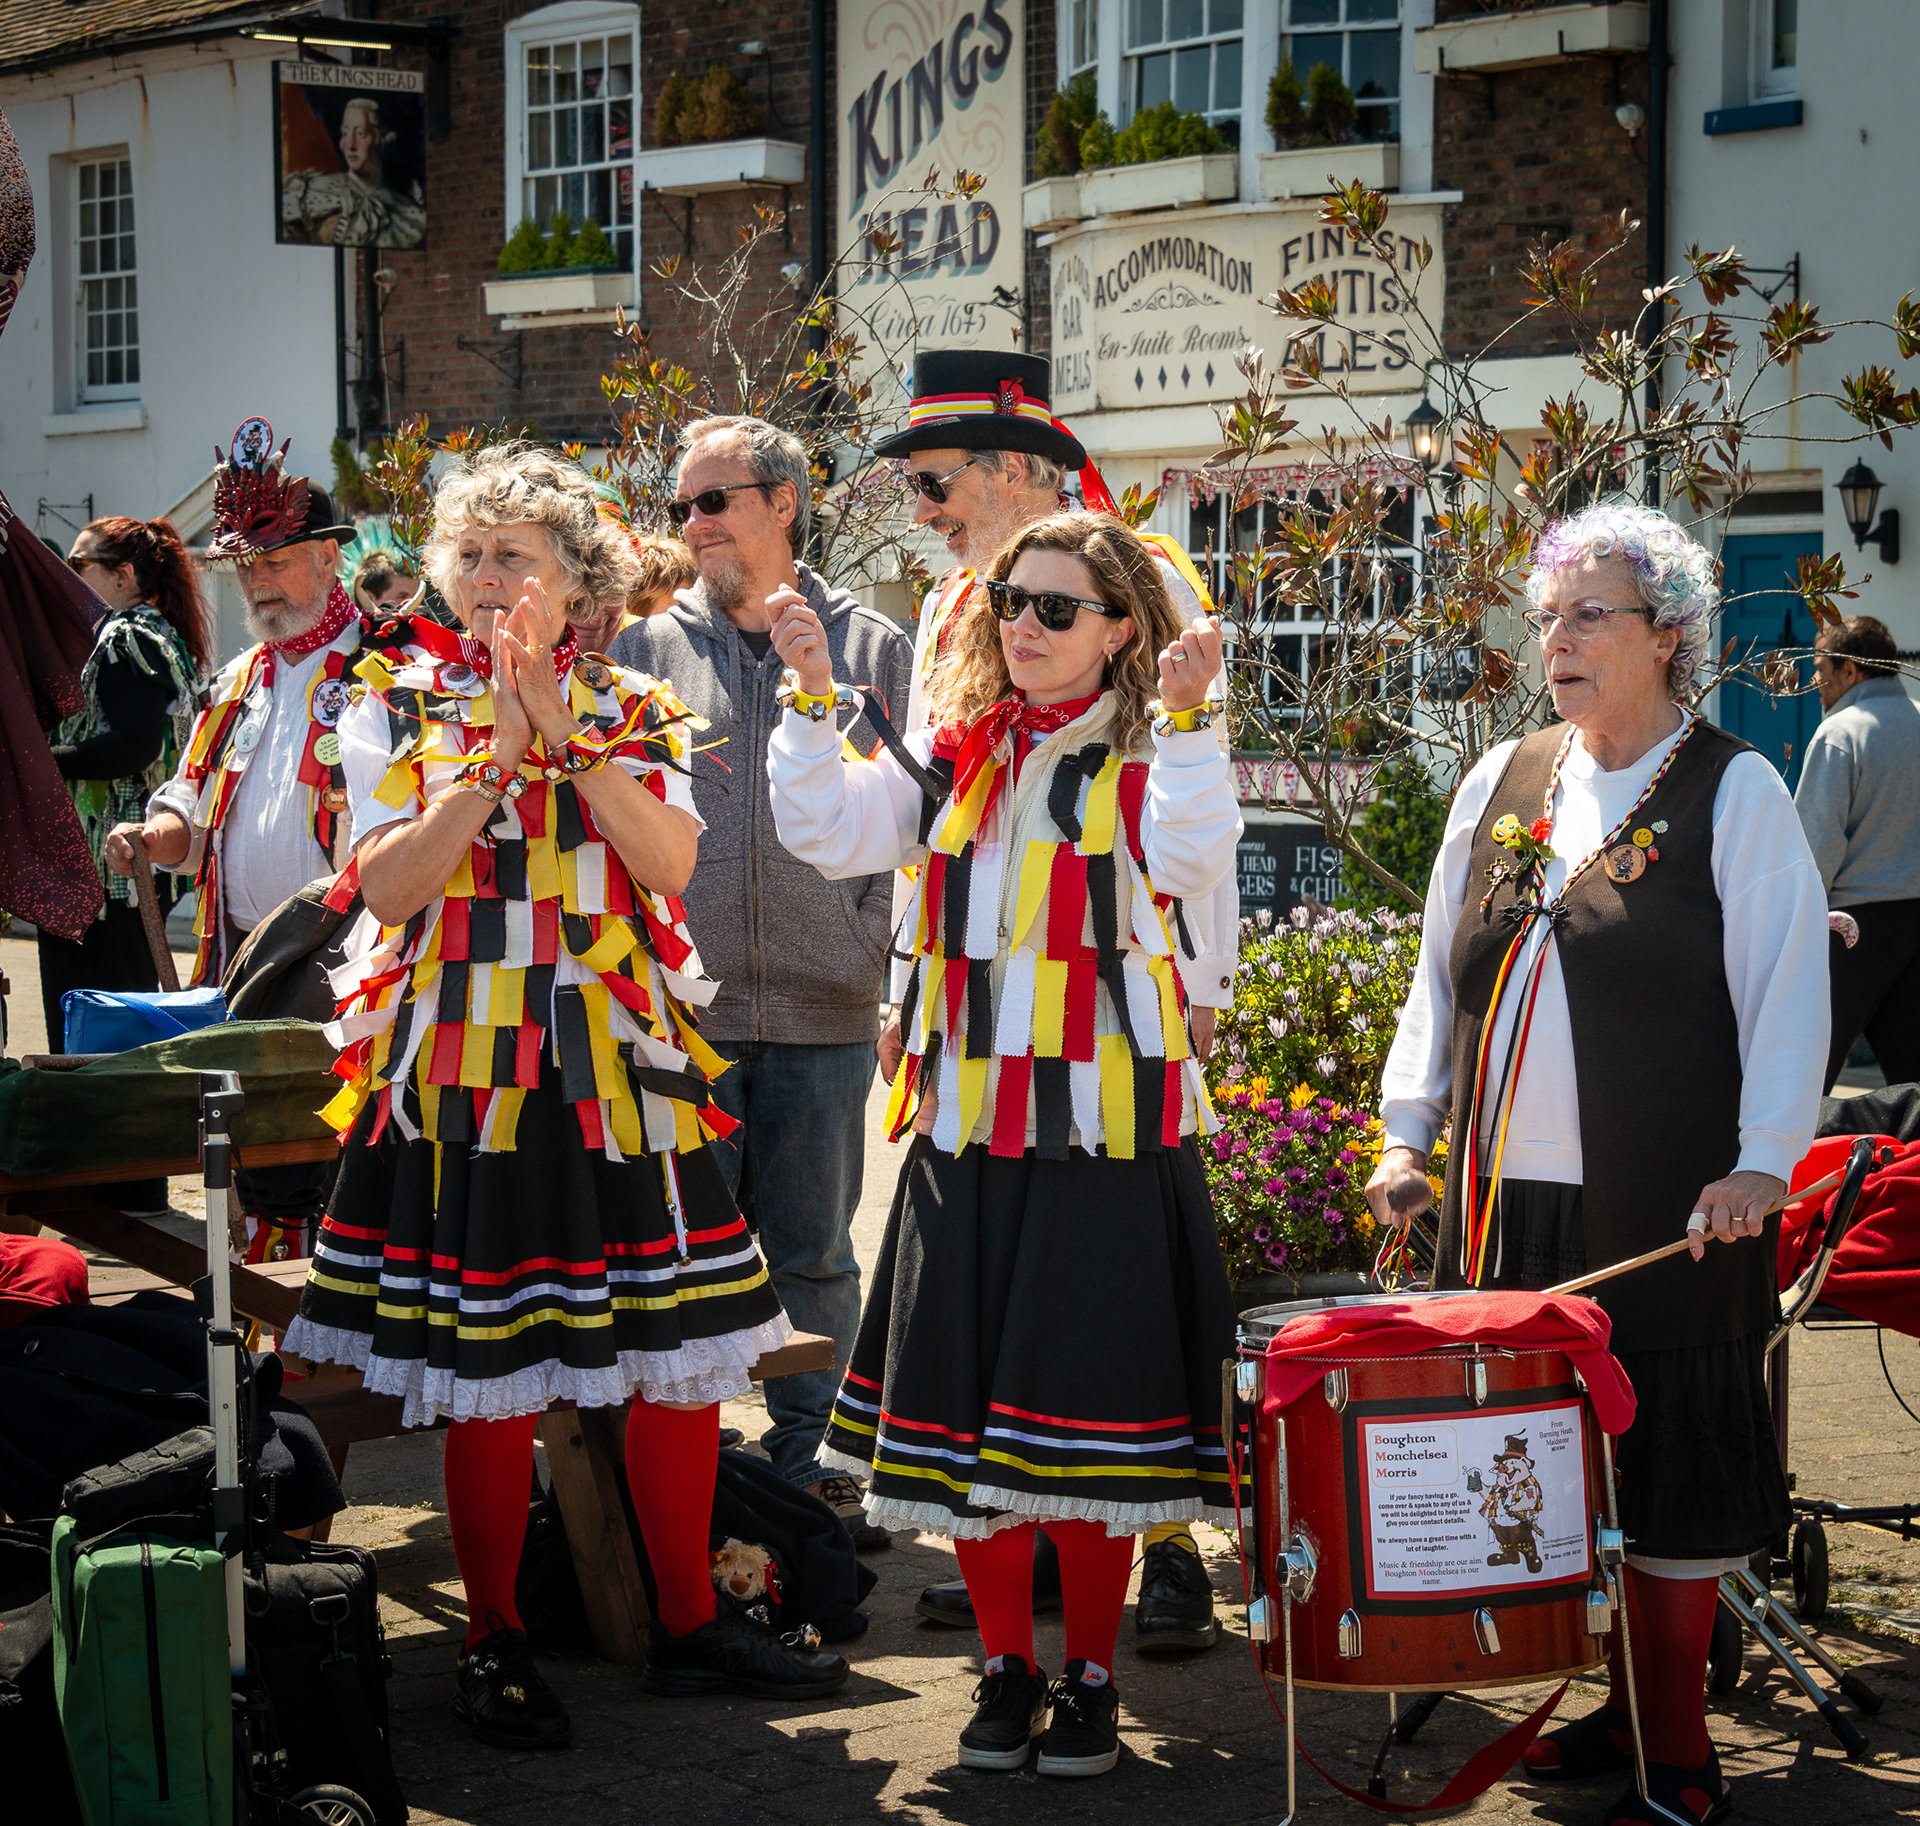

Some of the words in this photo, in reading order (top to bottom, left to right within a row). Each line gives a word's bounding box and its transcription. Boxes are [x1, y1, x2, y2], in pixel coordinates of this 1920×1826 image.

[288, 63, 320, 82] THE
[376, 72, 417, 90] HEAD
[848, 0, 1012, 210] KINGS
[858, 200, 1001, 286] HEAD
[1095, 237, 1252, 308] ACCOMMODATION
[869, 300, 936, 342] Circa
[1062, 296, 1083, 340] BAR
[1098, 330, 1174, 360] En-Suite
[1180, 324, 1250, 354] Rooms
[1281, 329, 1411, 373] ALES
[1055, 350, 1091, 396] MEALS
[1243, 855, 1277, 873] HEAD
[1237, 874, 1276, 897] GERS
[1374, 1433, 1436, 1448] Boughton
[1375, 1449, 1448, 1461] Monchelsea
[1376, 1467, 1417, 1478] Morris
[1425, 1492, 1444, 1500] having
[1409, 1509, 1437, 1518] delighted
[1445, 1508, 1458, 1516] help
[1420, 1518, 1443, 1526] contact
[1428, 1535, 1444, 1543] great
[1384, 1570, 1417, 1579] Boughton
[1418, 1568, 1459, 1577] Monchelsea
[1409, 1560, 1443, 1569] friendship
